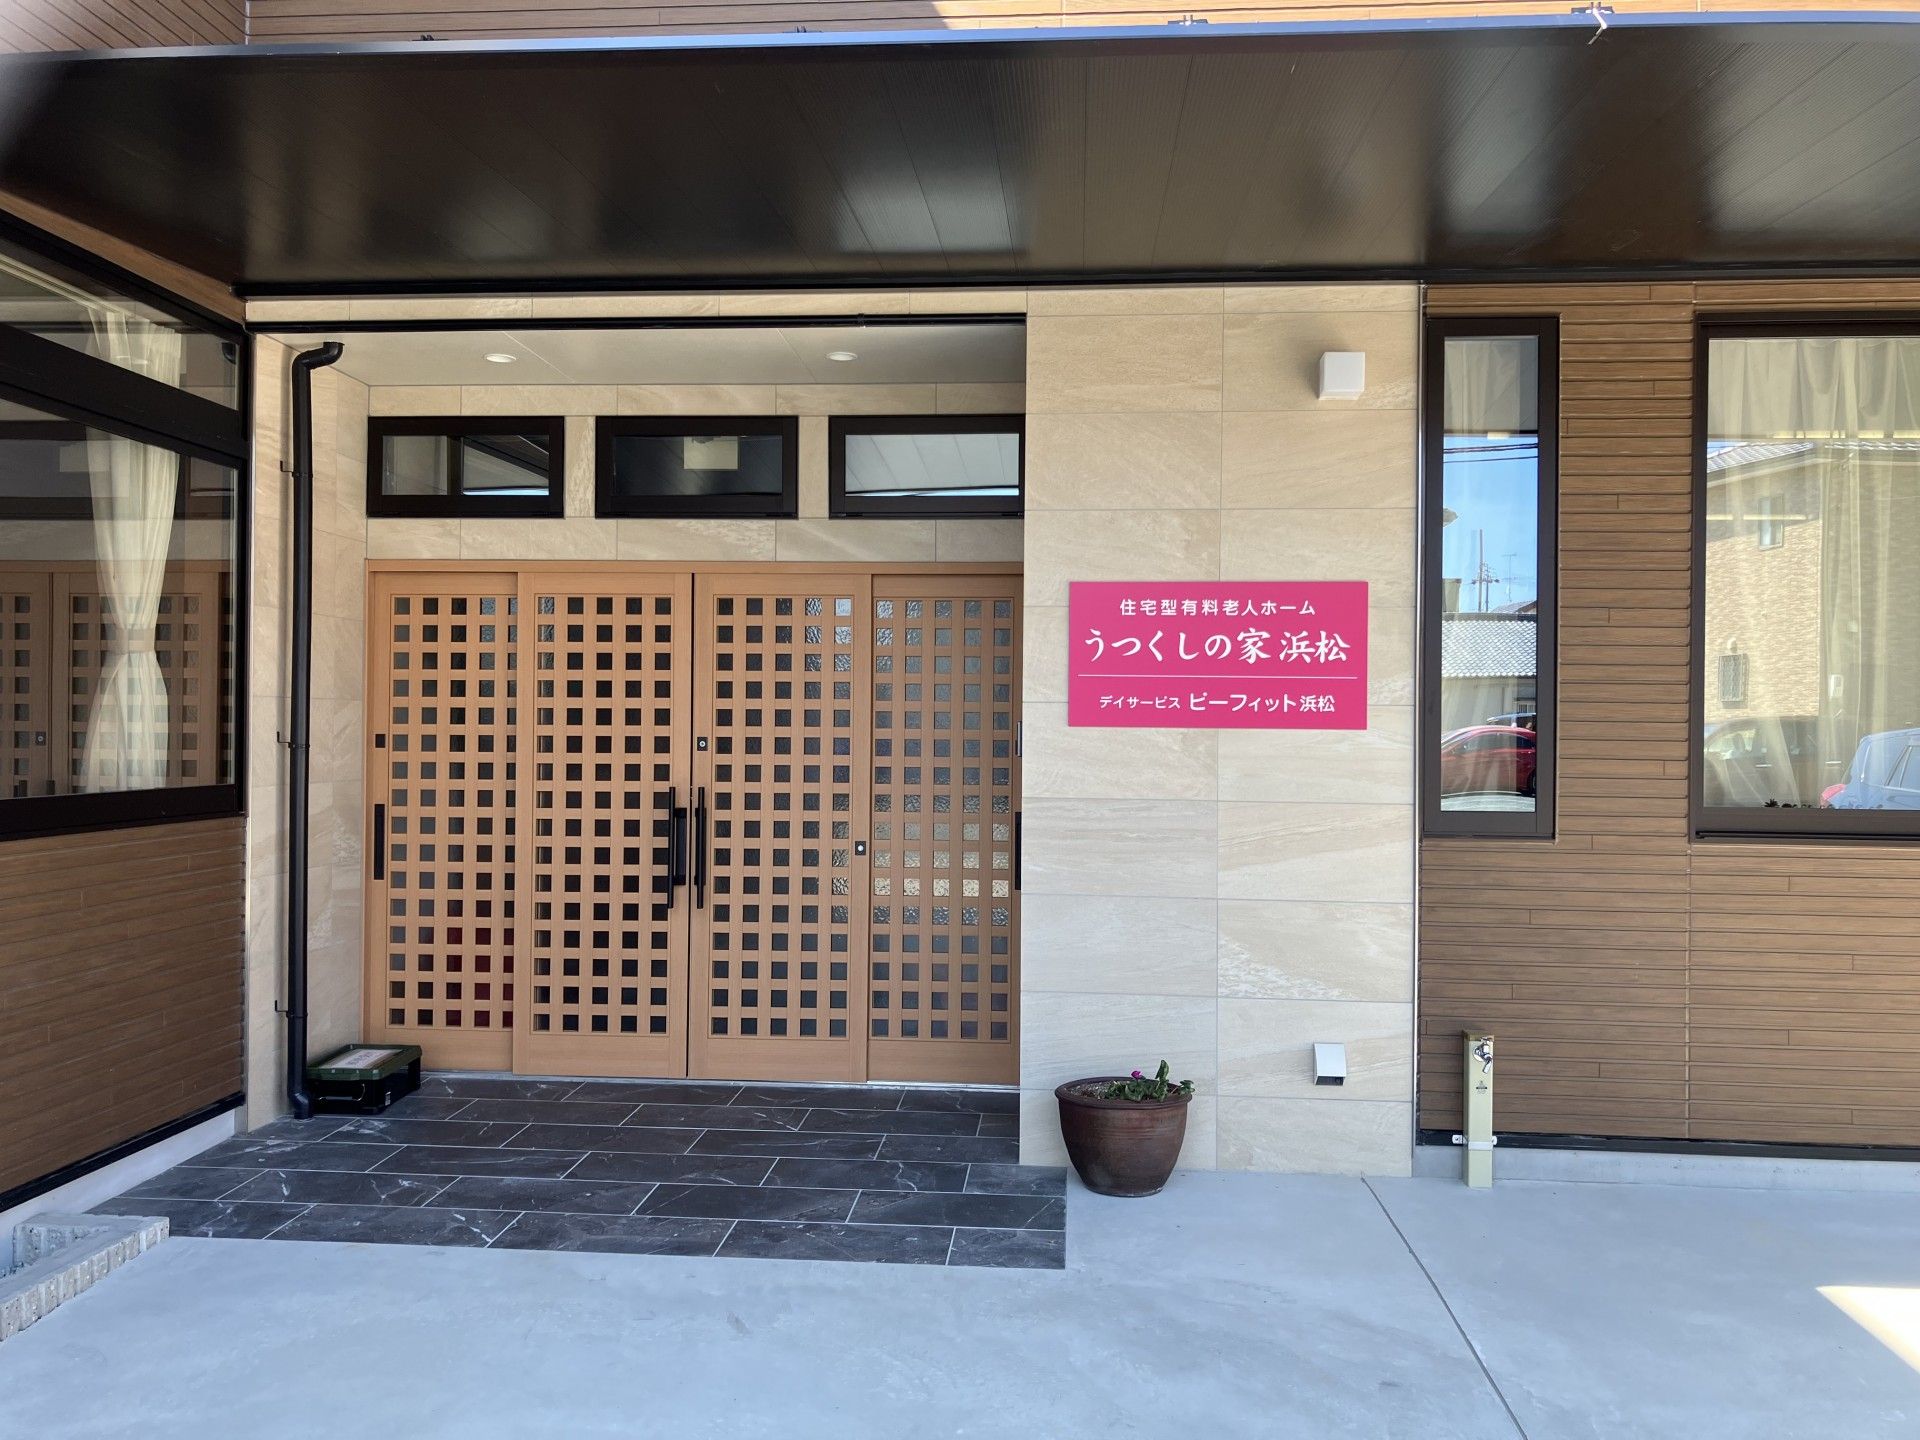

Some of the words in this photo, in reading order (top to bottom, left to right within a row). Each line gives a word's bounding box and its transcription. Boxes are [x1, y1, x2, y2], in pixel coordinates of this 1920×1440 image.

[1120, 598, 1316, 617] 住宅型有料老人ホーム
[1085, 627, 1272, 664] うつくしの家
[1278, 630, 1351, 664] 浜松
[1099, 695, 1181, 709] デイサービス
